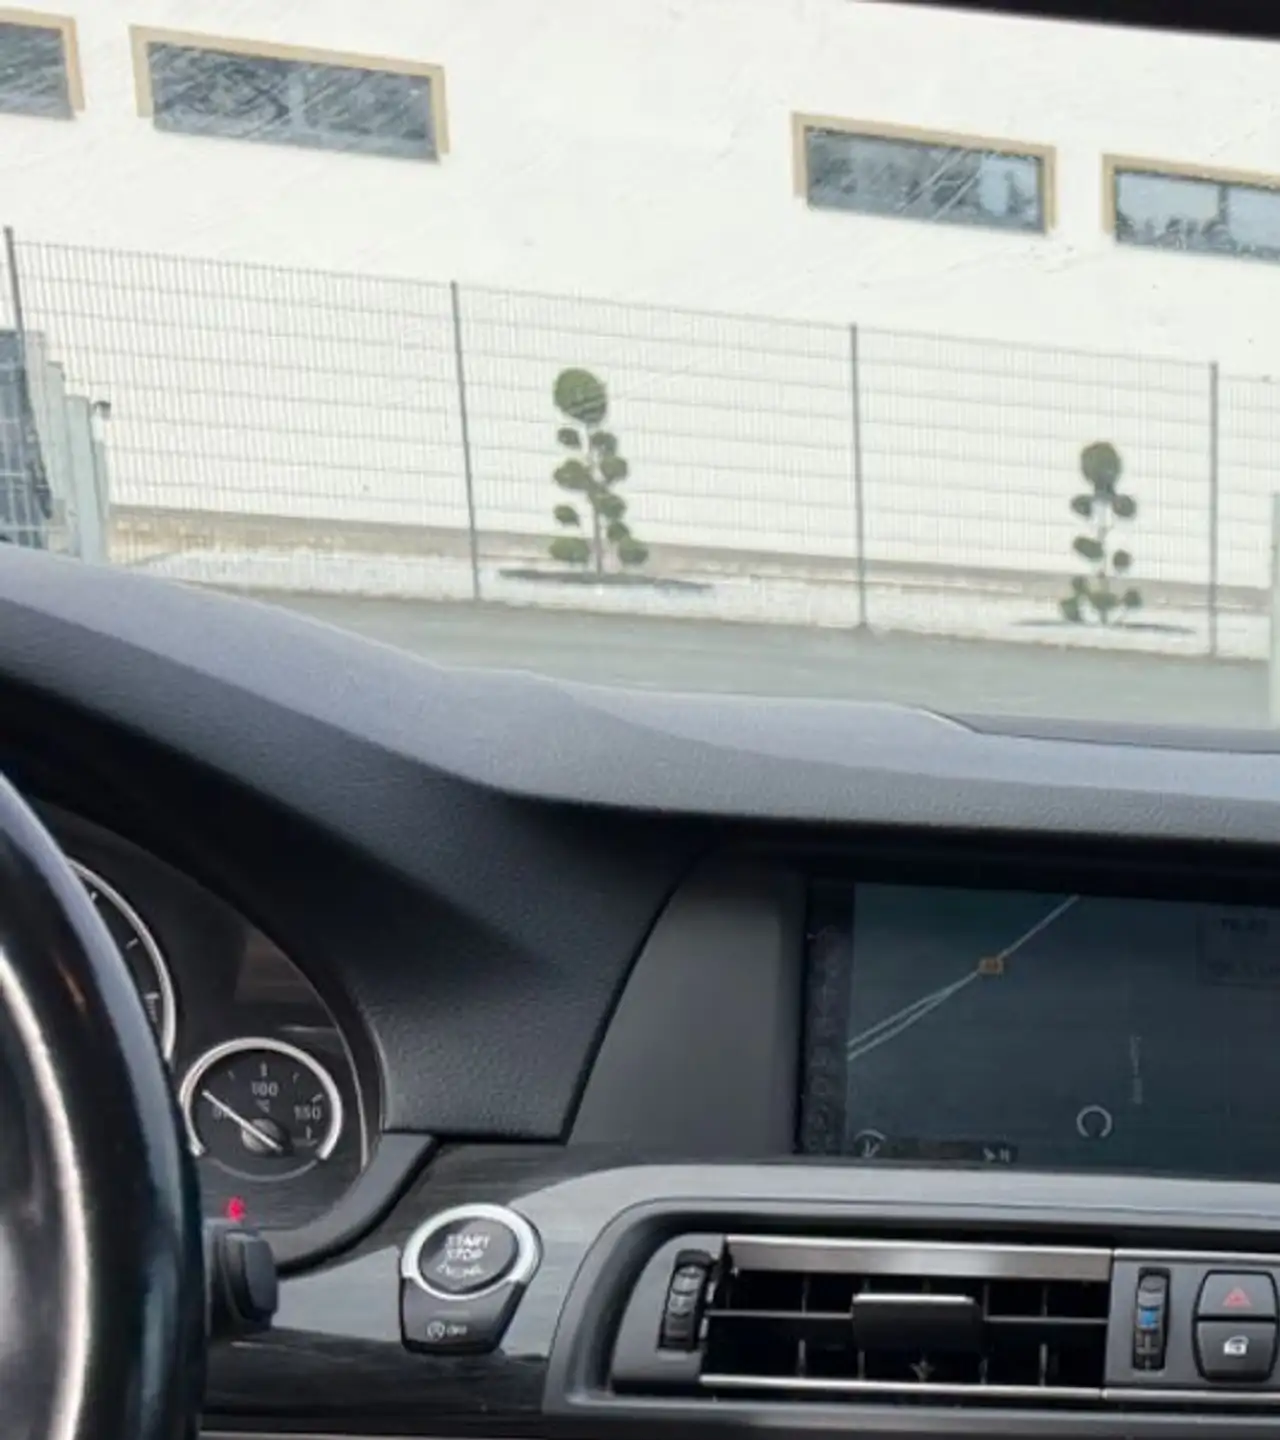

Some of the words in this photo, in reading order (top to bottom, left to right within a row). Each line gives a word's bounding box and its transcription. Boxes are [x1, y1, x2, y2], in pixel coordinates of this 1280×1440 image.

[251, 1080, 279, 1096] 100
[445, 1233, 490, 1249] START
[446, 1247, 484, 1261] STOP
